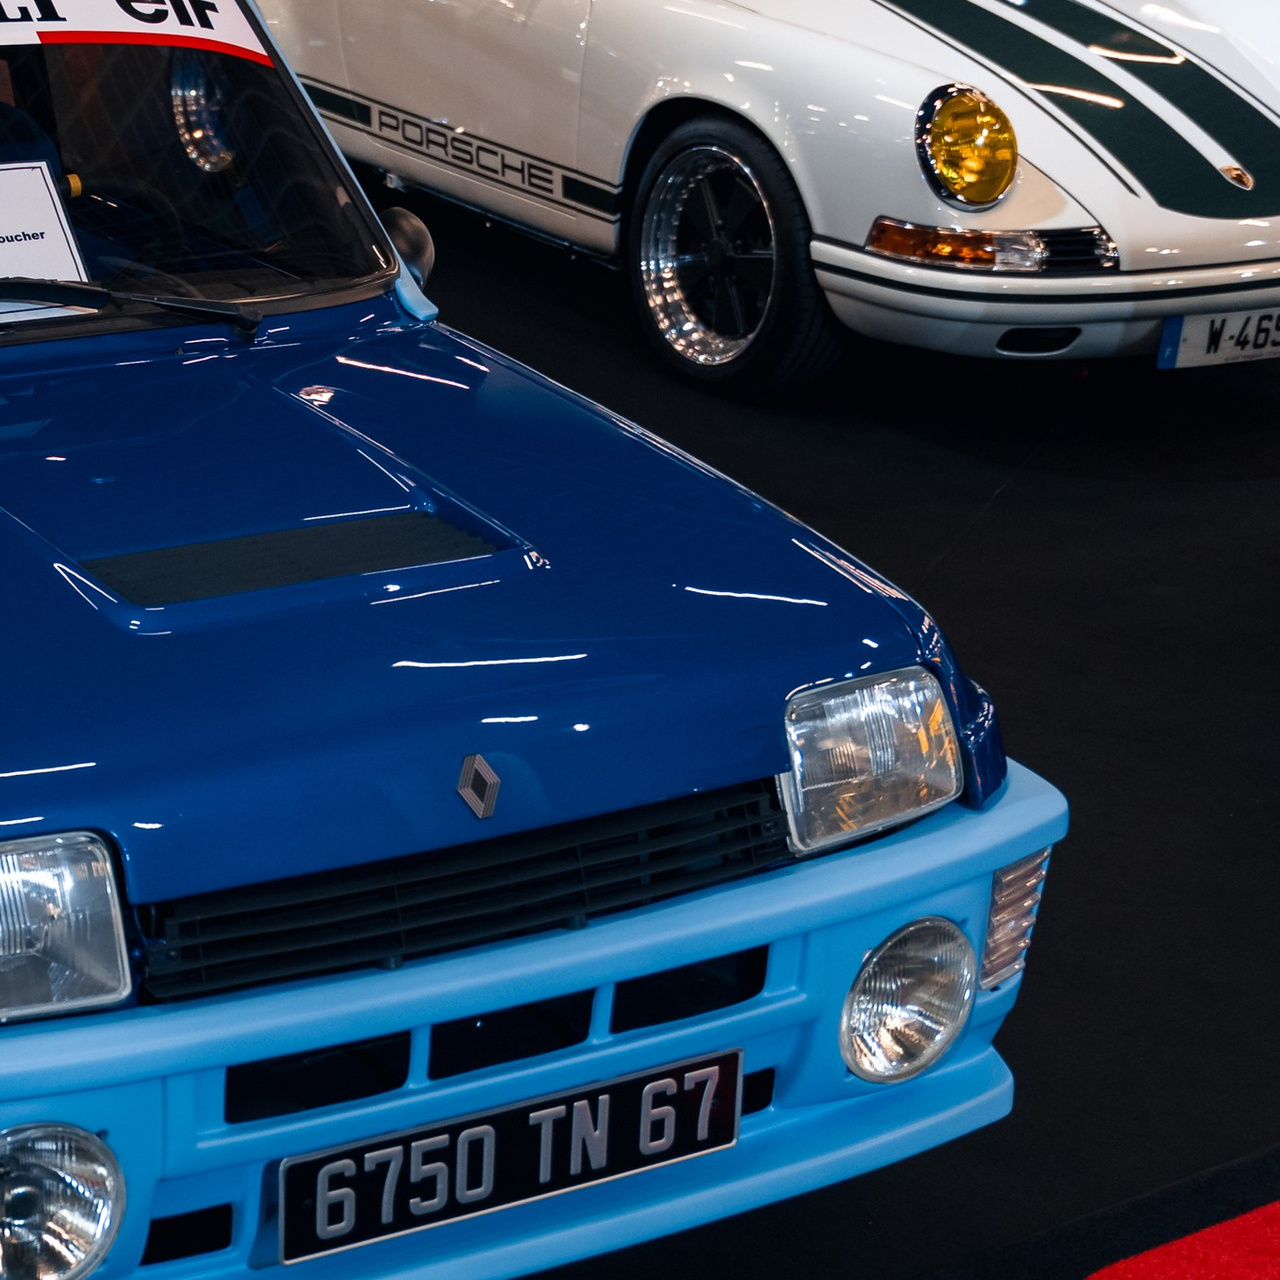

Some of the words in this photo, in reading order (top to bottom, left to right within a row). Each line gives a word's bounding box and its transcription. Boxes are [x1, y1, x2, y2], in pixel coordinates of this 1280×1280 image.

[379, 110, 553, 195] PORSCHE
[316, 1124, 495, 1240] 6750
[528, 1094, 610, 1183] TN
[639, 1065, 719, 1156] 67
